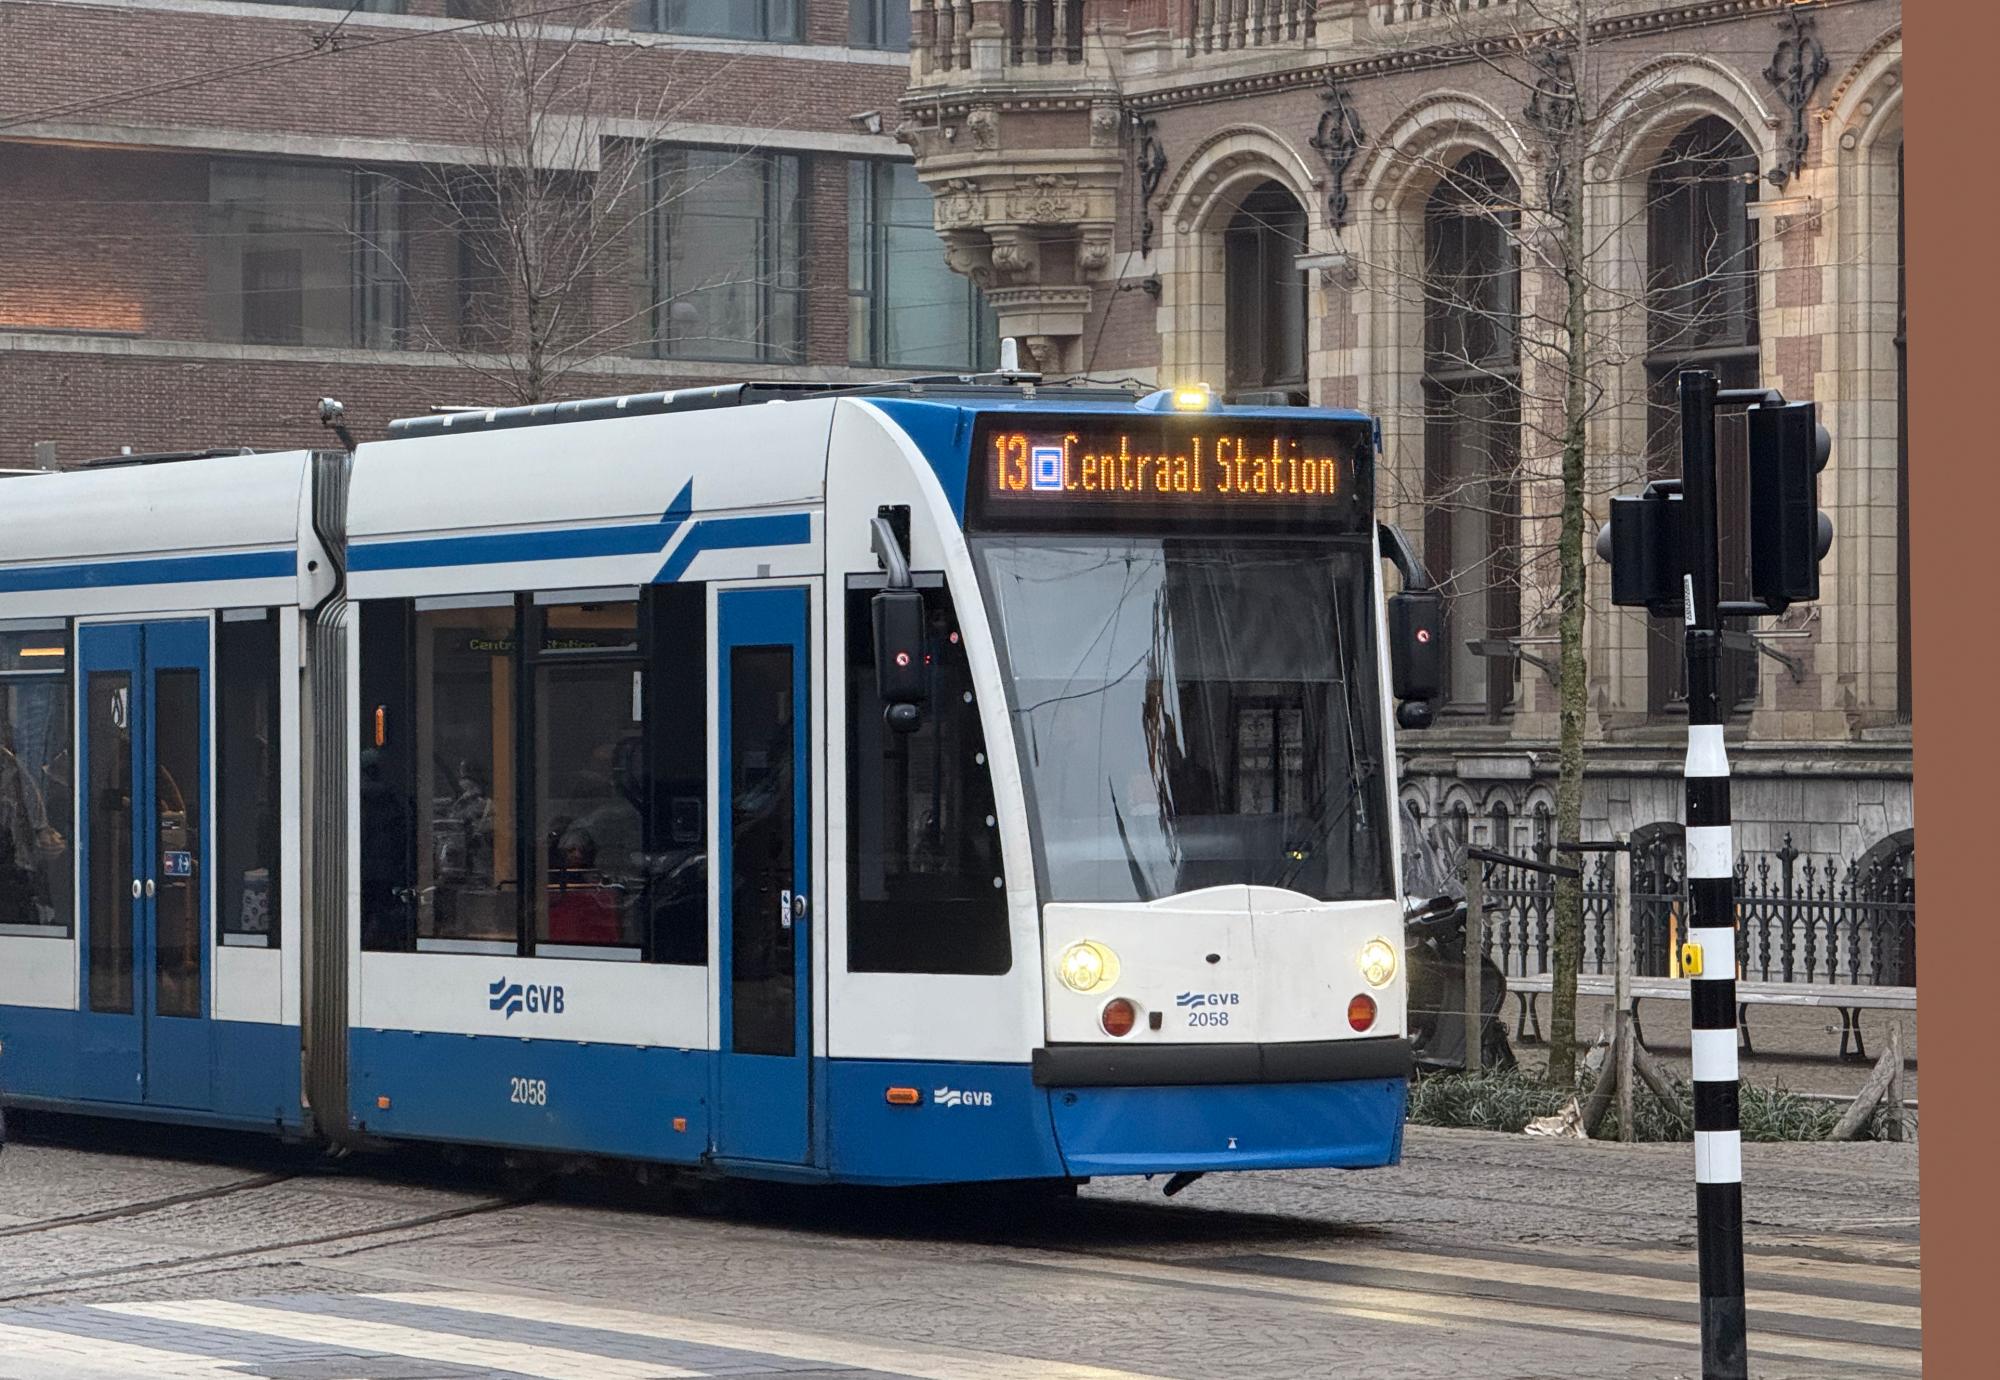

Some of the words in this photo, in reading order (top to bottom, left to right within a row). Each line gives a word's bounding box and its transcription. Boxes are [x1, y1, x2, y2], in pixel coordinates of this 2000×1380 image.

[995, 434, 1028, 491] 13
[1063, 434, 1202, 493] Centraal
[1216, 437, 1335, 495] Station
[469, 639, 522, 651] Centr
[526, 984, 565, 1014] GVB
[1207, 993, 1240, 1006] GVB
[1188, 1011, 1229, 1027] 2058
[510, 1076, 547, 1106] 2058
[962, 1091, 993, 1107] GVB
